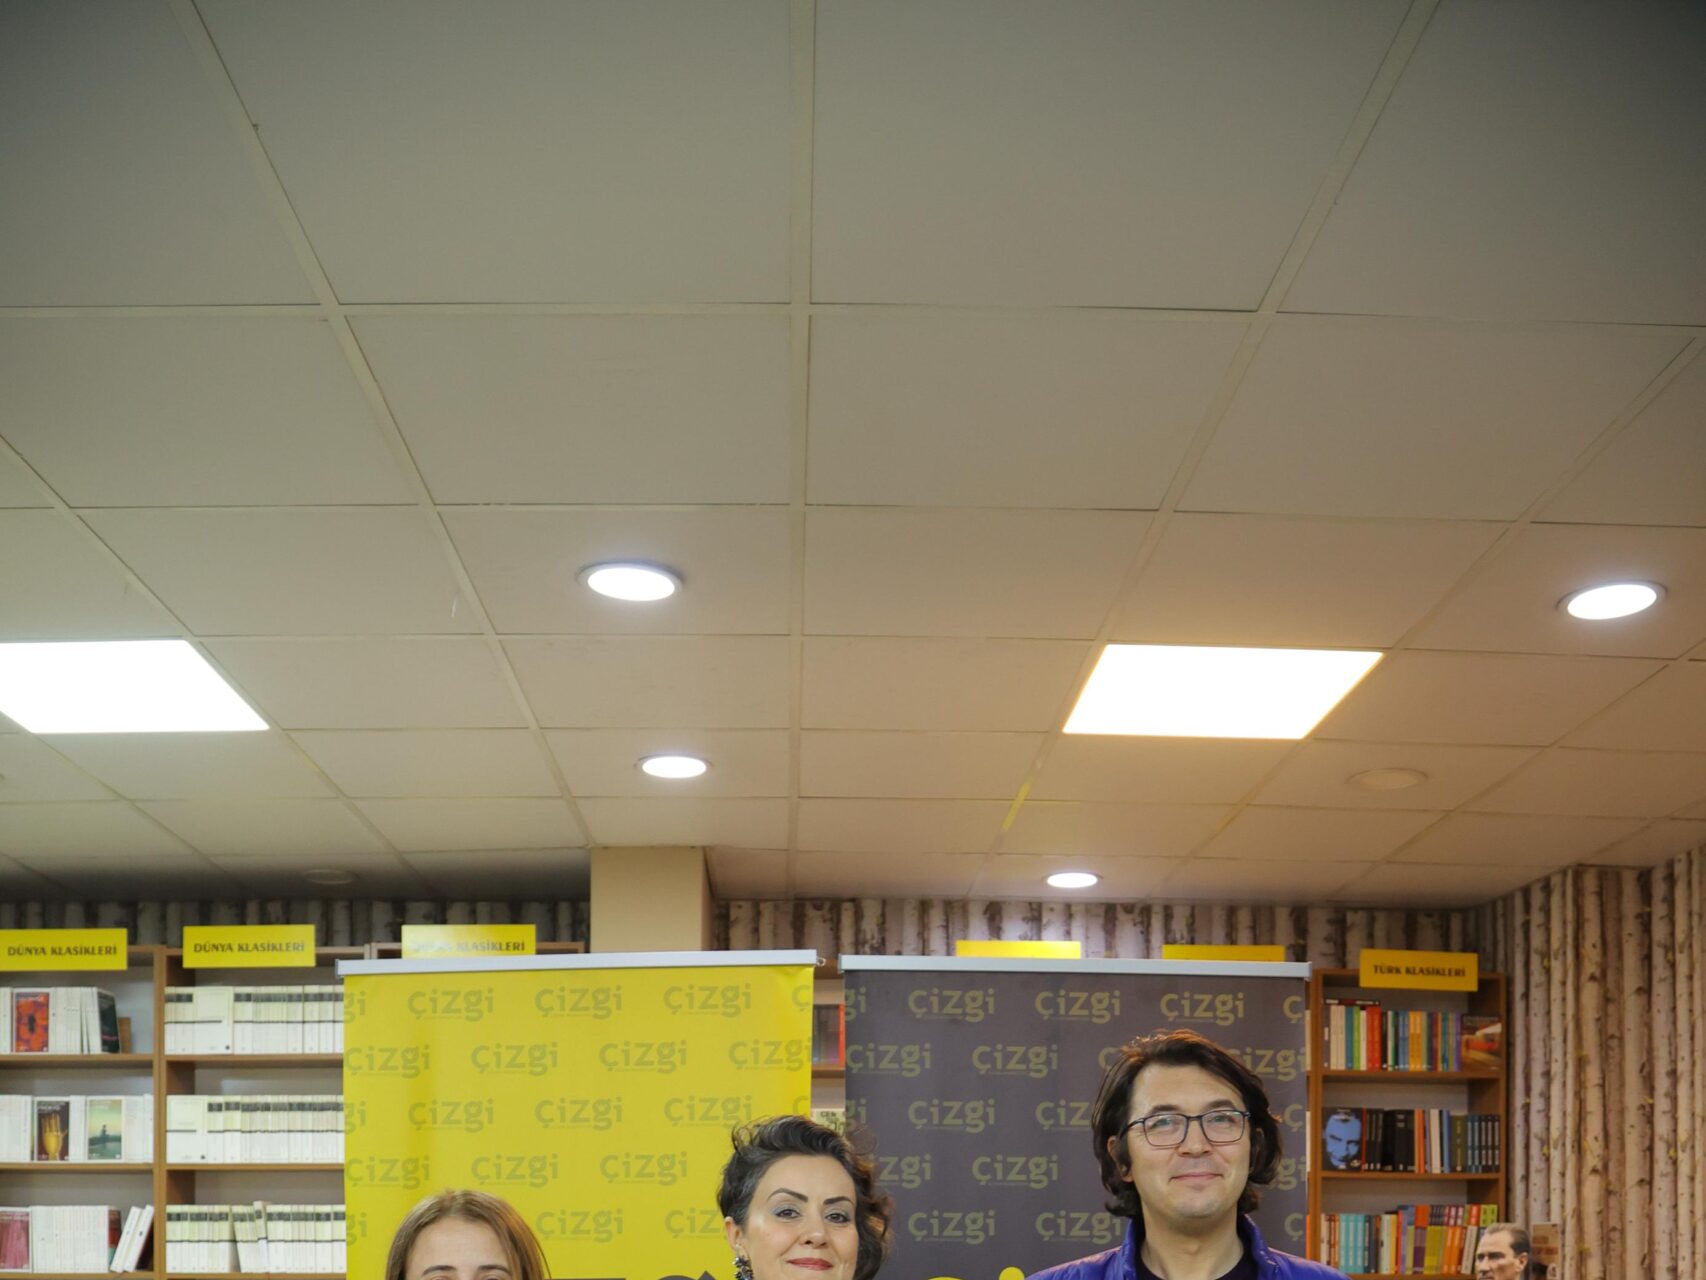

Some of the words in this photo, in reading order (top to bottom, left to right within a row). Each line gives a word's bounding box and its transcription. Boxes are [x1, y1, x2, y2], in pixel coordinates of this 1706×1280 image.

[7, 944, 47, 957] DÜNYA
[50, 943, 117, 956] KLASİKLERİ
[194, 941, 234, 953] DÜNYA
[237, 939, 305, 953] KLASİKLERİ
[1373, 962, 1402, 975] TÜRK
[1405, 965, 1466, 978] KLASİKLERİ
